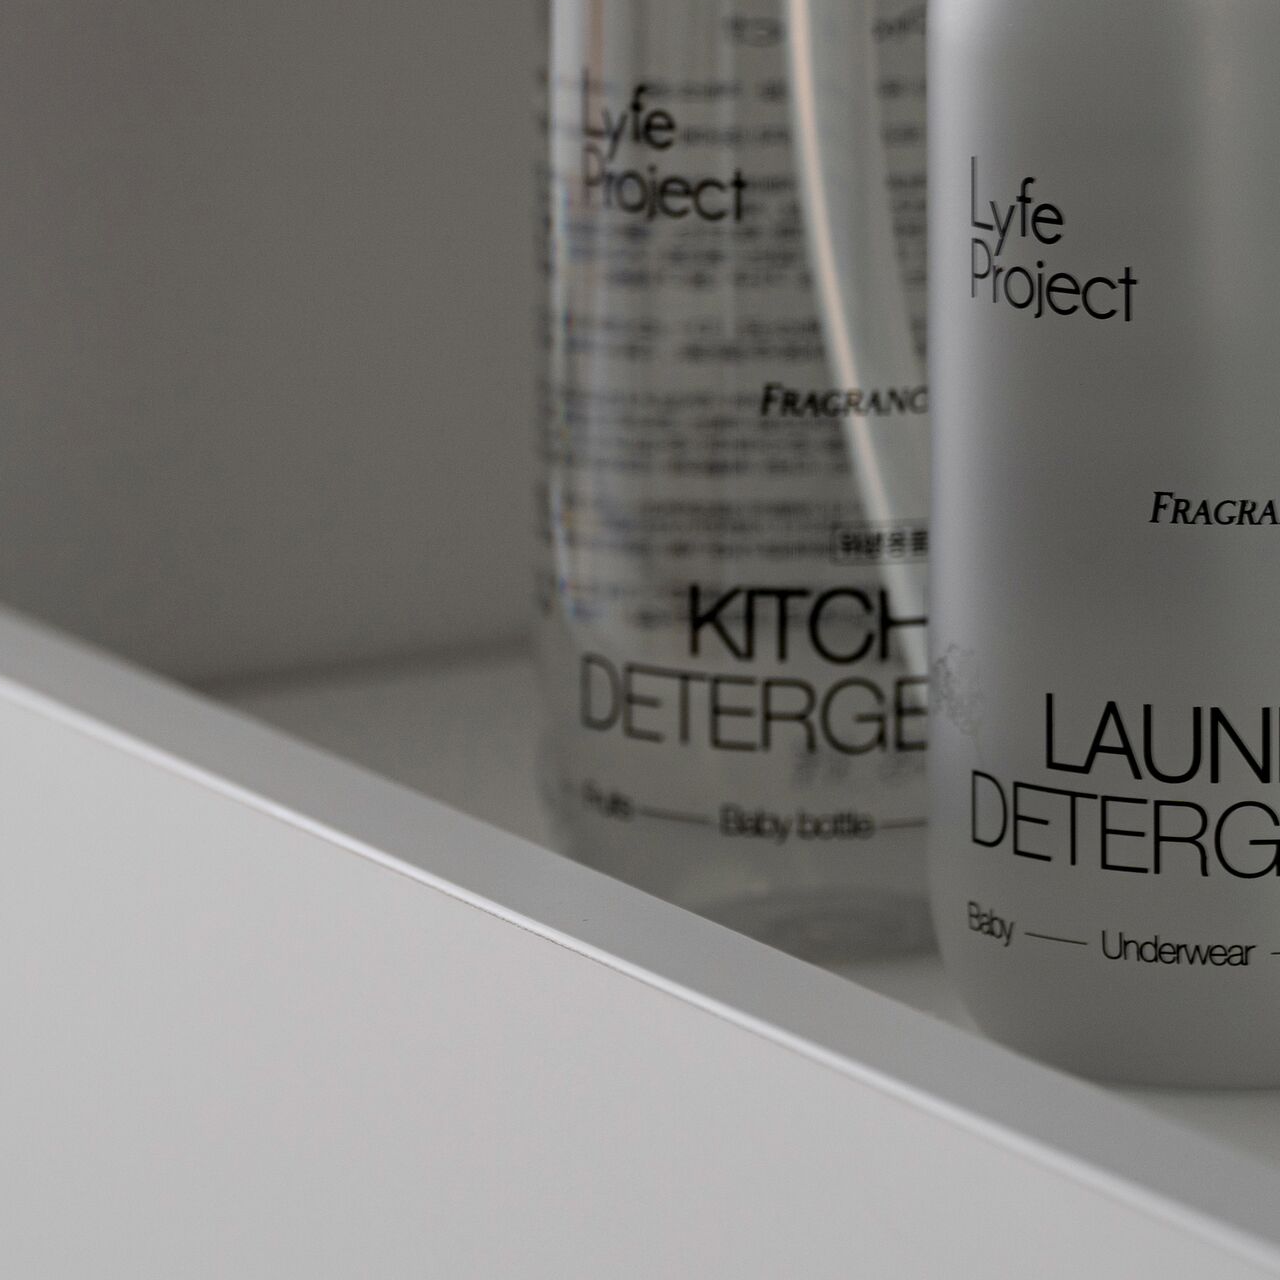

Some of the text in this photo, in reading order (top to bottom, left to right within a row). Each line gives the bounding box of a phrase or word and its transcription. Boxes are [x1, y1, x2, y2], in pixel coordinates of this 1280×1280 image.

[582, 63, 675, 162] Lyfe
[582, 142, 747, 224] Project
[971, 156, 1064, 257] Lyfe
[971, 237, 1138, 322] Project
[967, 901, 1015, 947] Baby
[1102, 930, 1257, 966] Underwear
